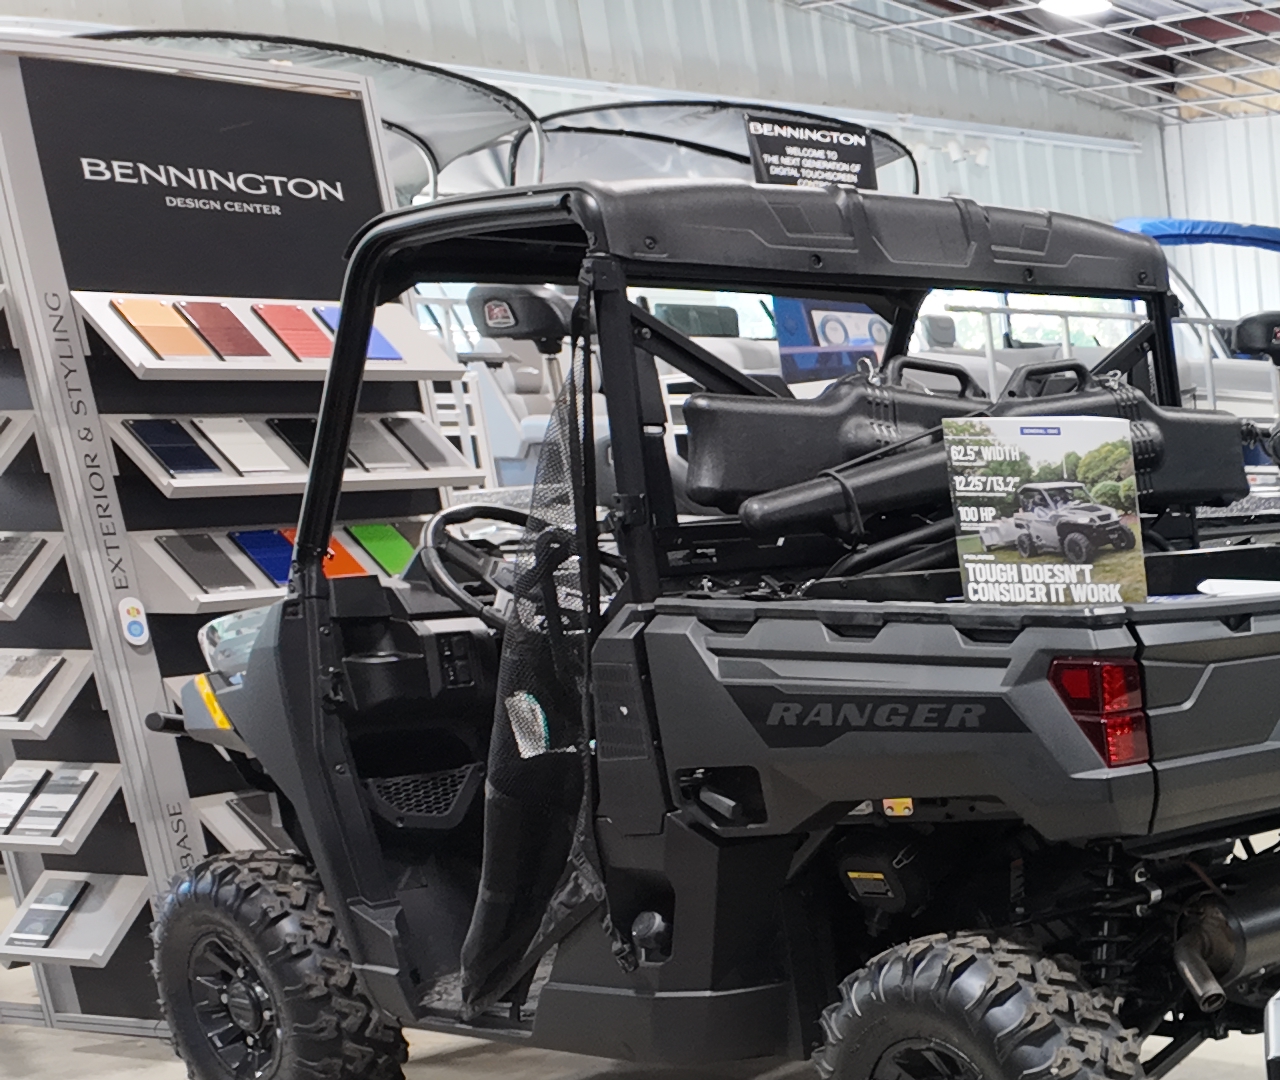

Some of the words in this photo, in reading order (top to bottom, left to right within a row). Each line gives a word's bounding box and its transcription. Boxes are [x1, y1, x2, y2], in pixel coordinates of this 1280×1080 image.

[749, 121, 866, 146] BENNINGTON
[80, 157, 345, 202] BENNINGTON
[165, 196, 221, 211] DESIGN
[224, 201, 282, 216] CENTER
[46, 291, 88, 416] STYLING
[78, 427, 94, 442] &
[981, 446, 1021, 461] WIDTH
[84, 452, 128, 591] EXTERIOR
[958, 506, 979, 522] 100
[979, 507, 997, 522] HP
[965, 563, 1019, 583] TOUGH
[1020, 564, 1093, 583] DOESN'T
[967, 582, 1048, 602] CONSIDER
[1050, 583, 1067, 603] IT
[1069, 583, 1123, 603] WORK
[766, 702, 986, 728] RANGER
[166, 802, 195, 869] BASE
